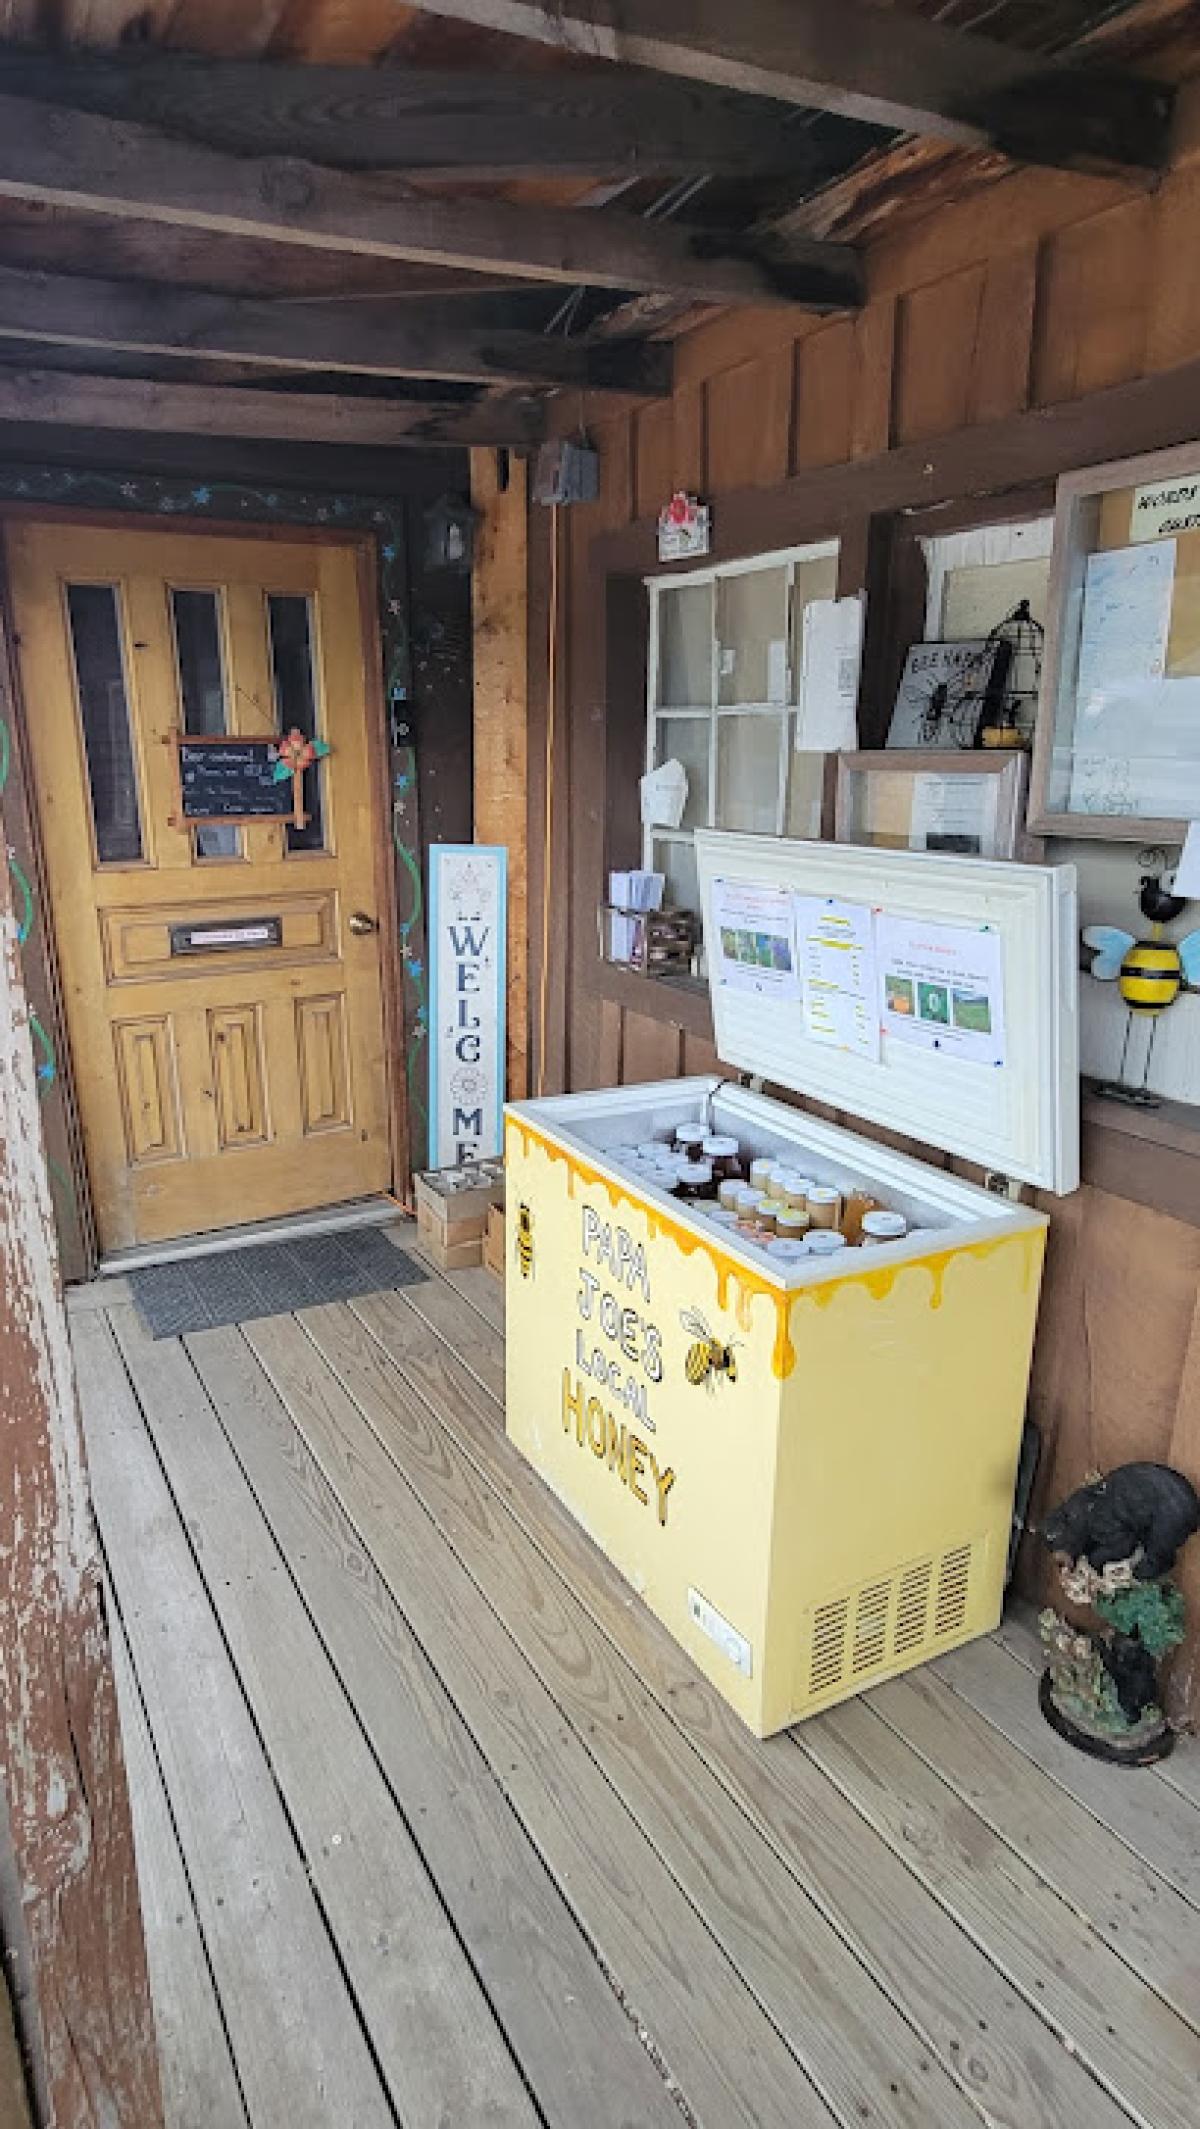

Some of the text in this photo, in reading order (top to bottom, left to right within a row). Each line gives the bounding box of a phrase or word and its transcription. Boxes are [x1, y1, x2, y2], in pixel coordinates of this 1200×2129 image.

[447, 925, 490, 1165] WELCOME
[582, 1204, 648, 1304] PAPA
[575, 1329, 654, 1434] LOCAL
[576, 1267, 661, 1383] JOE'S
[562, 1367, 677, 1526] HONEY
